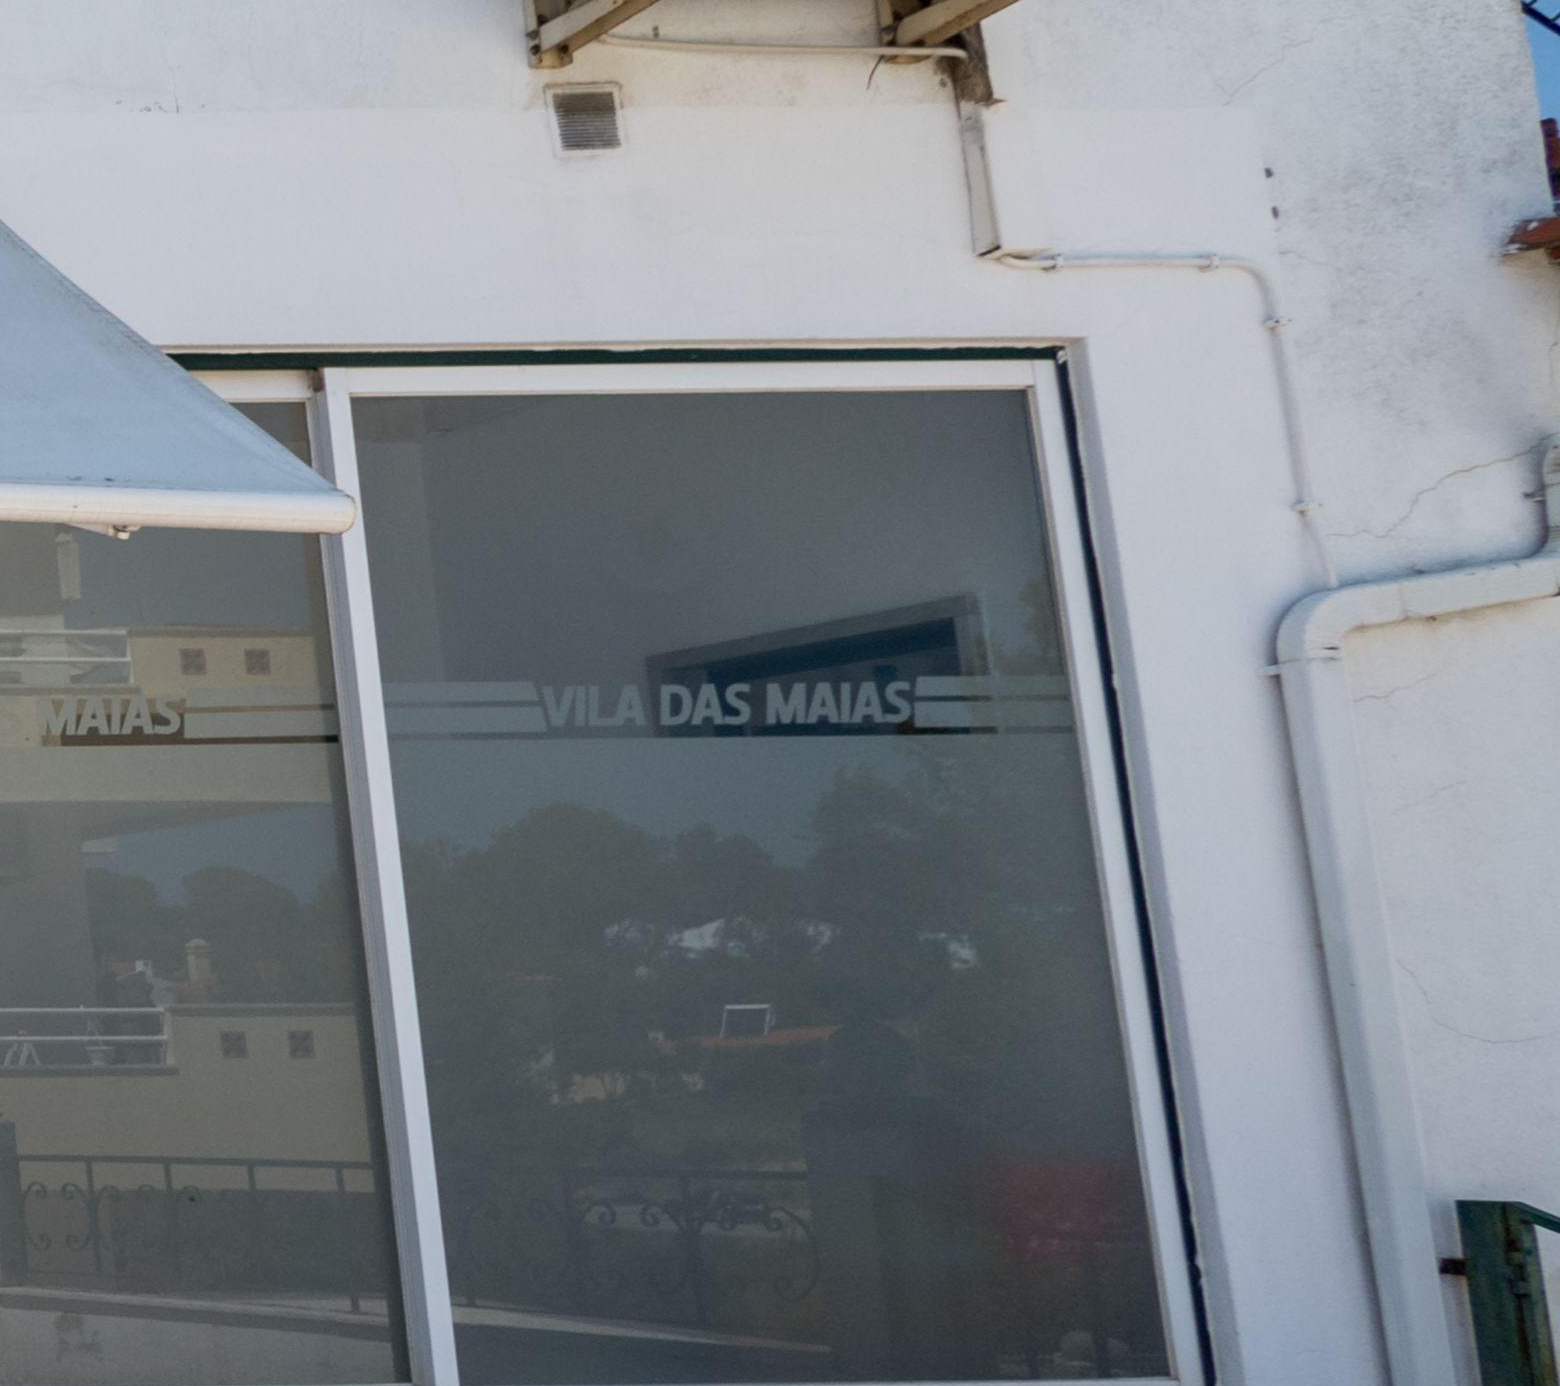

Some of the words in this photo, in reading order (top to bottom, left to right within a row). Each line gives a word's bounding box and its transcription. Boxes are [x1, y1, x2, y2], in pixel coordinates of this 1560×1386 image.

[39, 696, 185, 735] MAIAS
[542, 685, 646, 727] VILA
[660, 683, 751, 726] DAS
[765, 681, 912, 725] MAIAS
